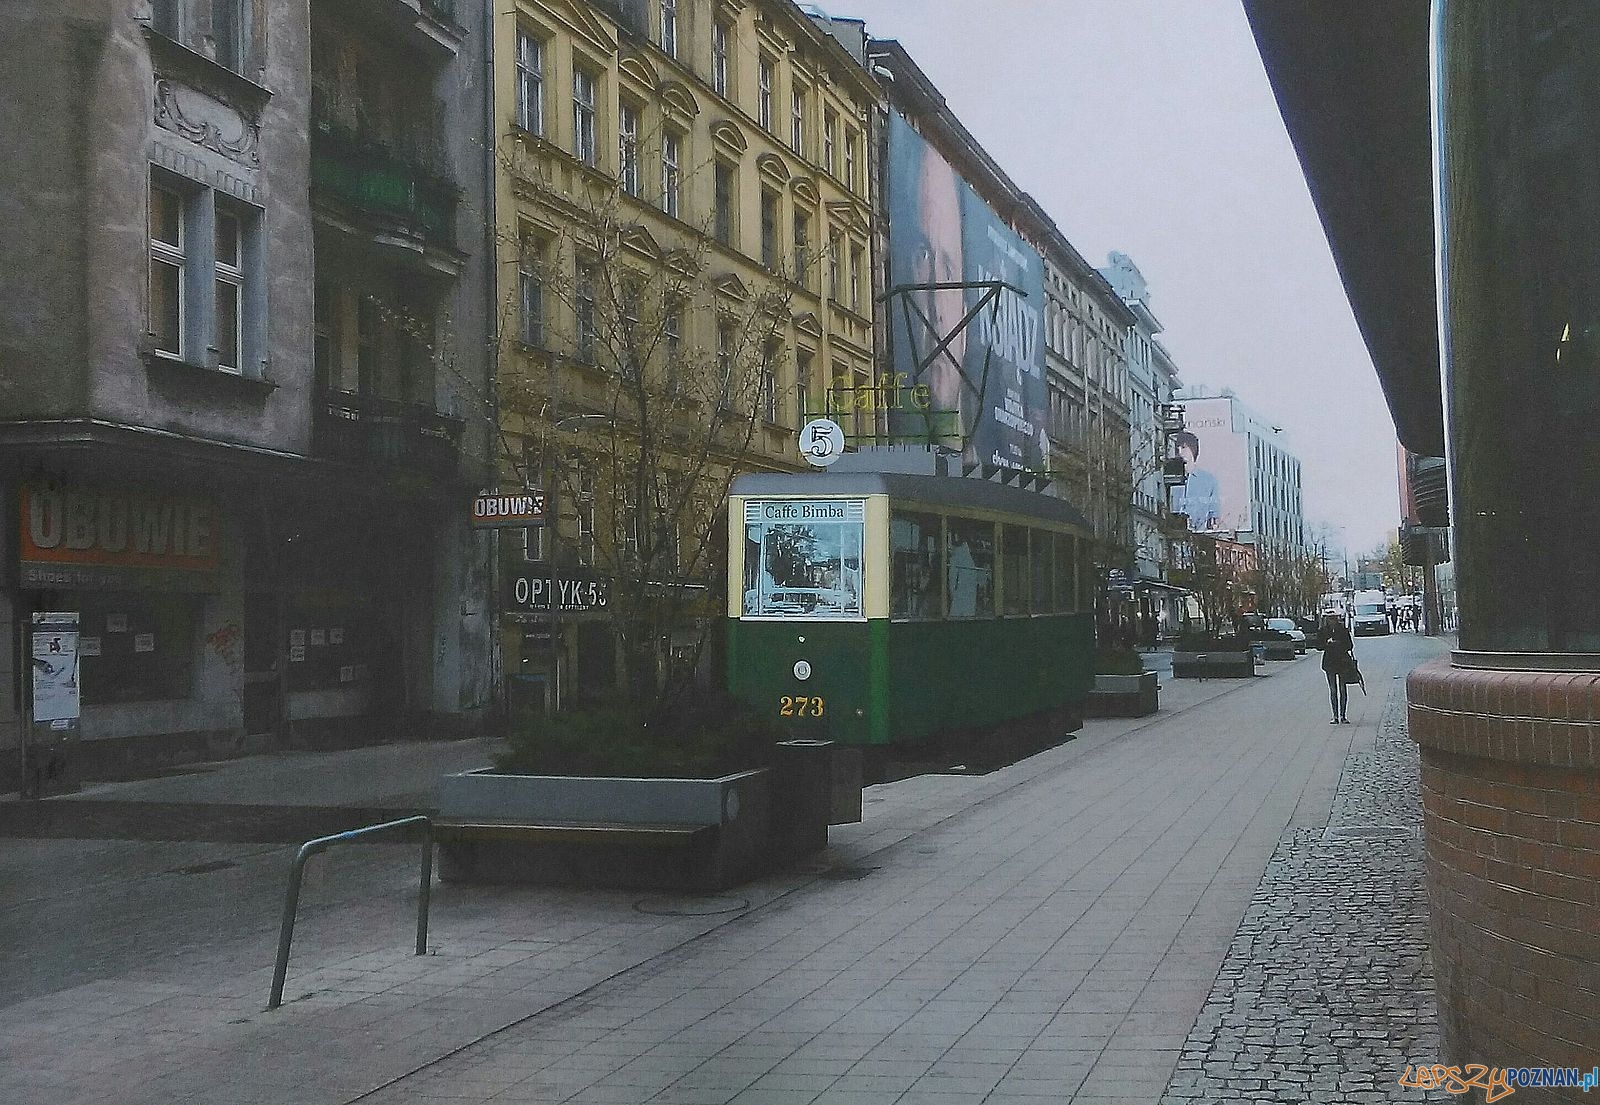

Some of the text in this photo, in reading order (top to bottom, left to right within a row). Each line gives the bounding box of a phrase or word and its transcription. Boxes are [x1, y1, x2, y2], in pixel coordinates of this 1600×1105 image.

[829, 371, 931, 409] Caffe
[811, 426, 834, 457] 5
[474, 495, 545, 517] OBUWIE
[765, 504, 844, 519] Caffe Bimba
[30, 491, 210, 556] OBUWIE
[779, 696, 825, 717] 273
